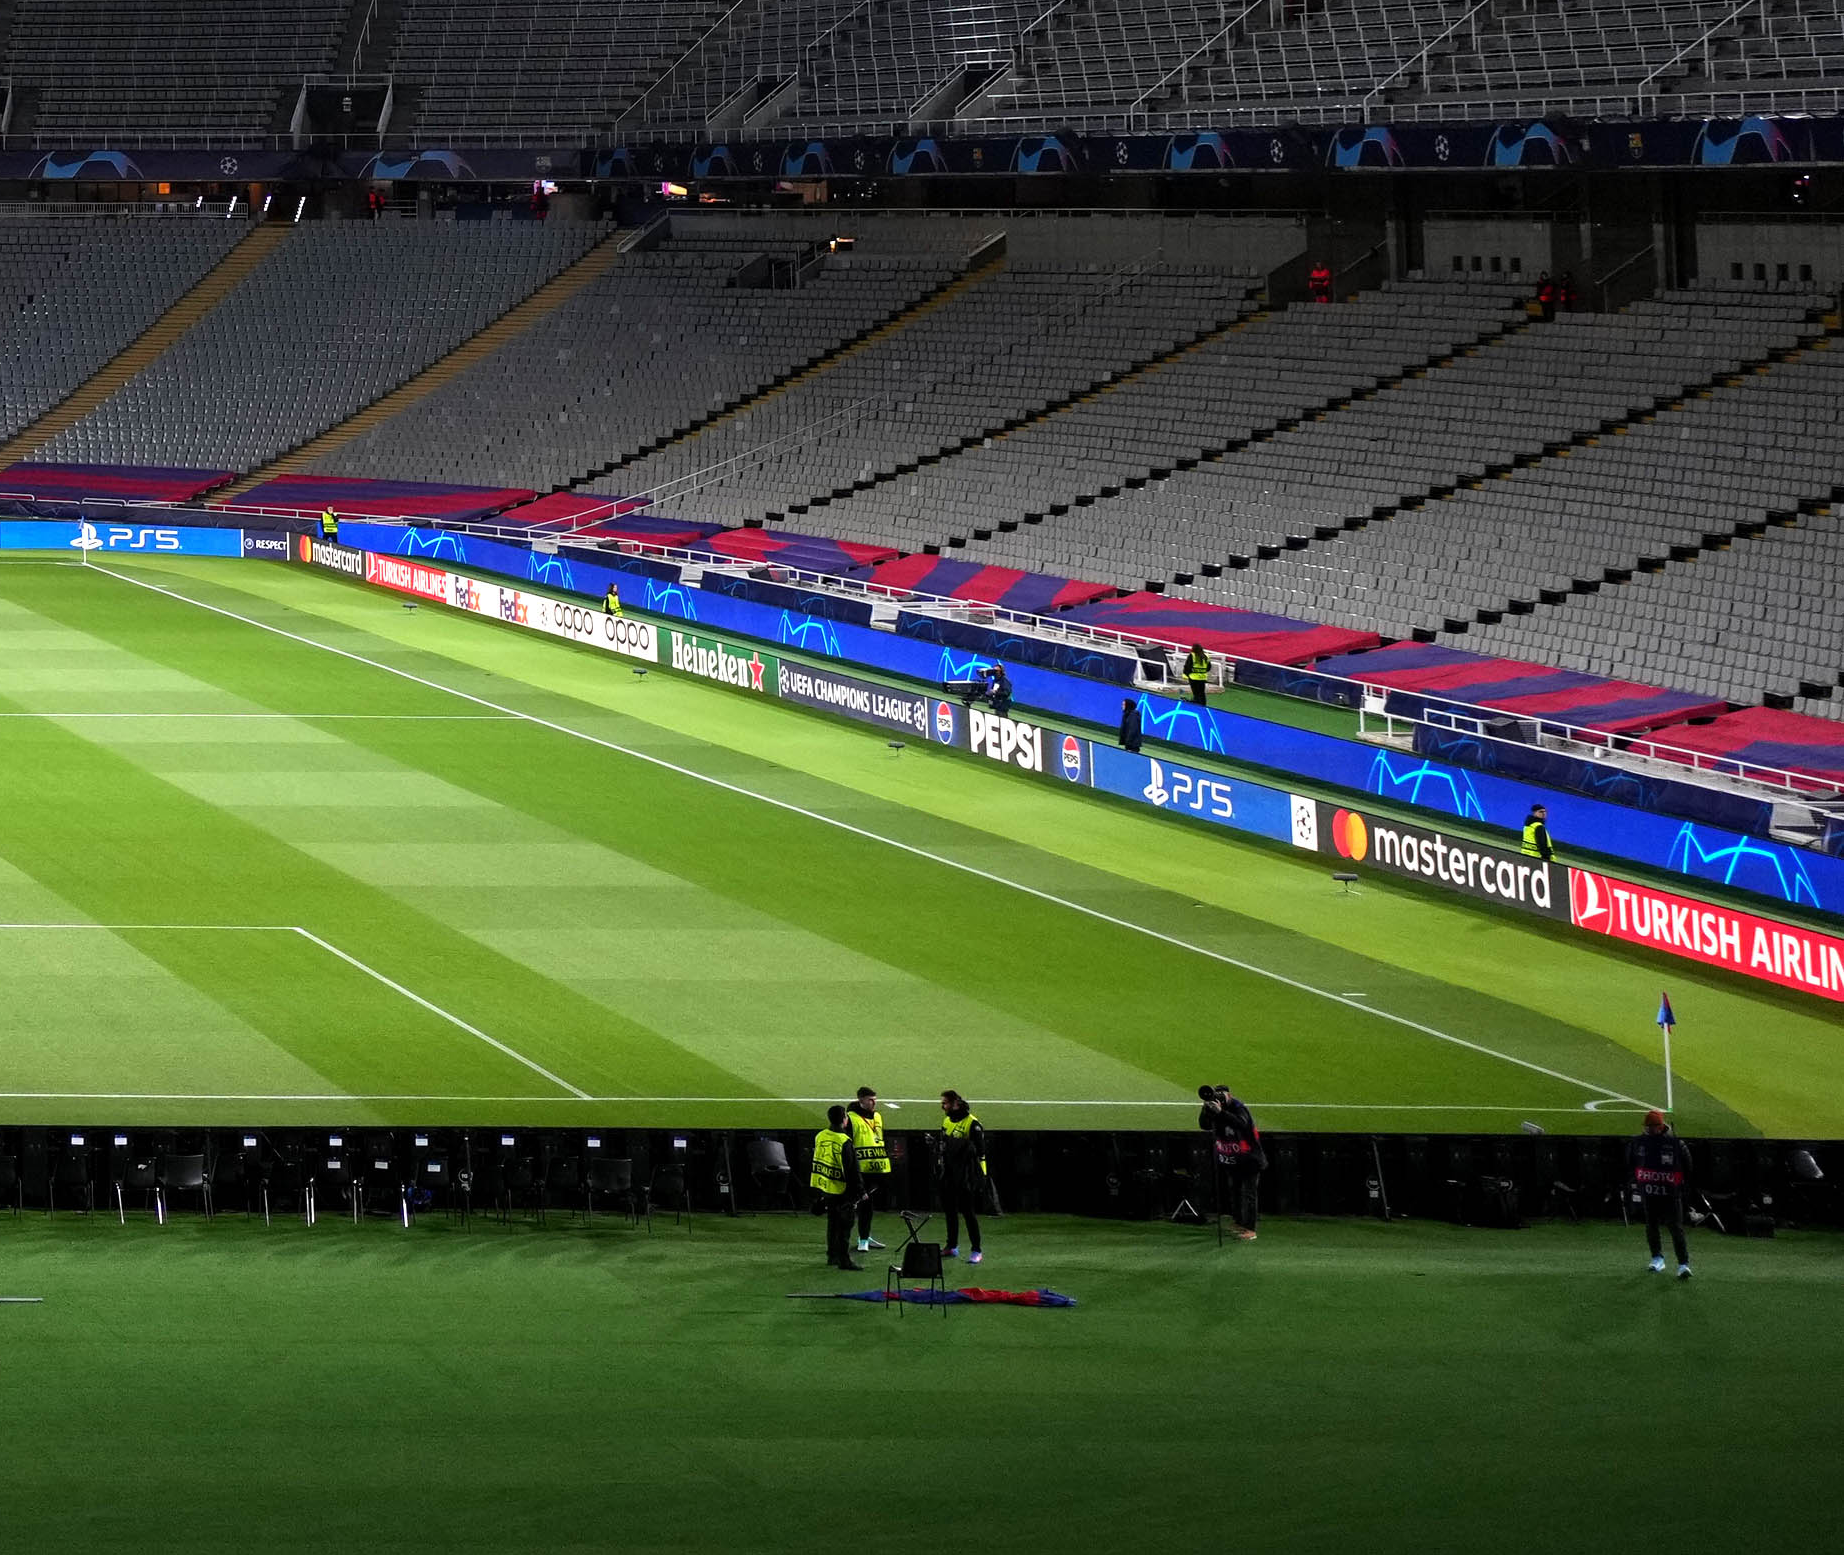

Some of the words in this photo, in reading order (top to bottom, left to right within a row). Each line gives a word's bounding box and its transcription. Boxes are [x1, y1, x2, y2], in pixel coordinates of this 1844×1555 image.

[109, 527, 179, 550] PS5
[256, 539, 287, 551] RESPECT
[313, 542, 362, 575] mastercard
[378, 559, 411, 589] TURKISH
[412, 566, 446, 599] AIRLINES
[455, 576, 480, 611] FedEx
[499, 587, 528, 624] FedEx
[554, 603, 593, 639] oppo
[604, 616, 649, 653] oppo
[670, 631, 750, 687] Heineken
[789, 672, 813, 695] UEFA
[814, 678, 869, 712] CHAMPIONS
[872, 693, 912, 724] LEAGUE
[969, 709, 1042, 772] PEPSI
[1172, 772, 1232, 818] PS5
[1374, 826, 1551, 908] mastercard
[1613, 889, 1741, 963] TURKISH
[813, 1163, 842, 1179] TEWARD
